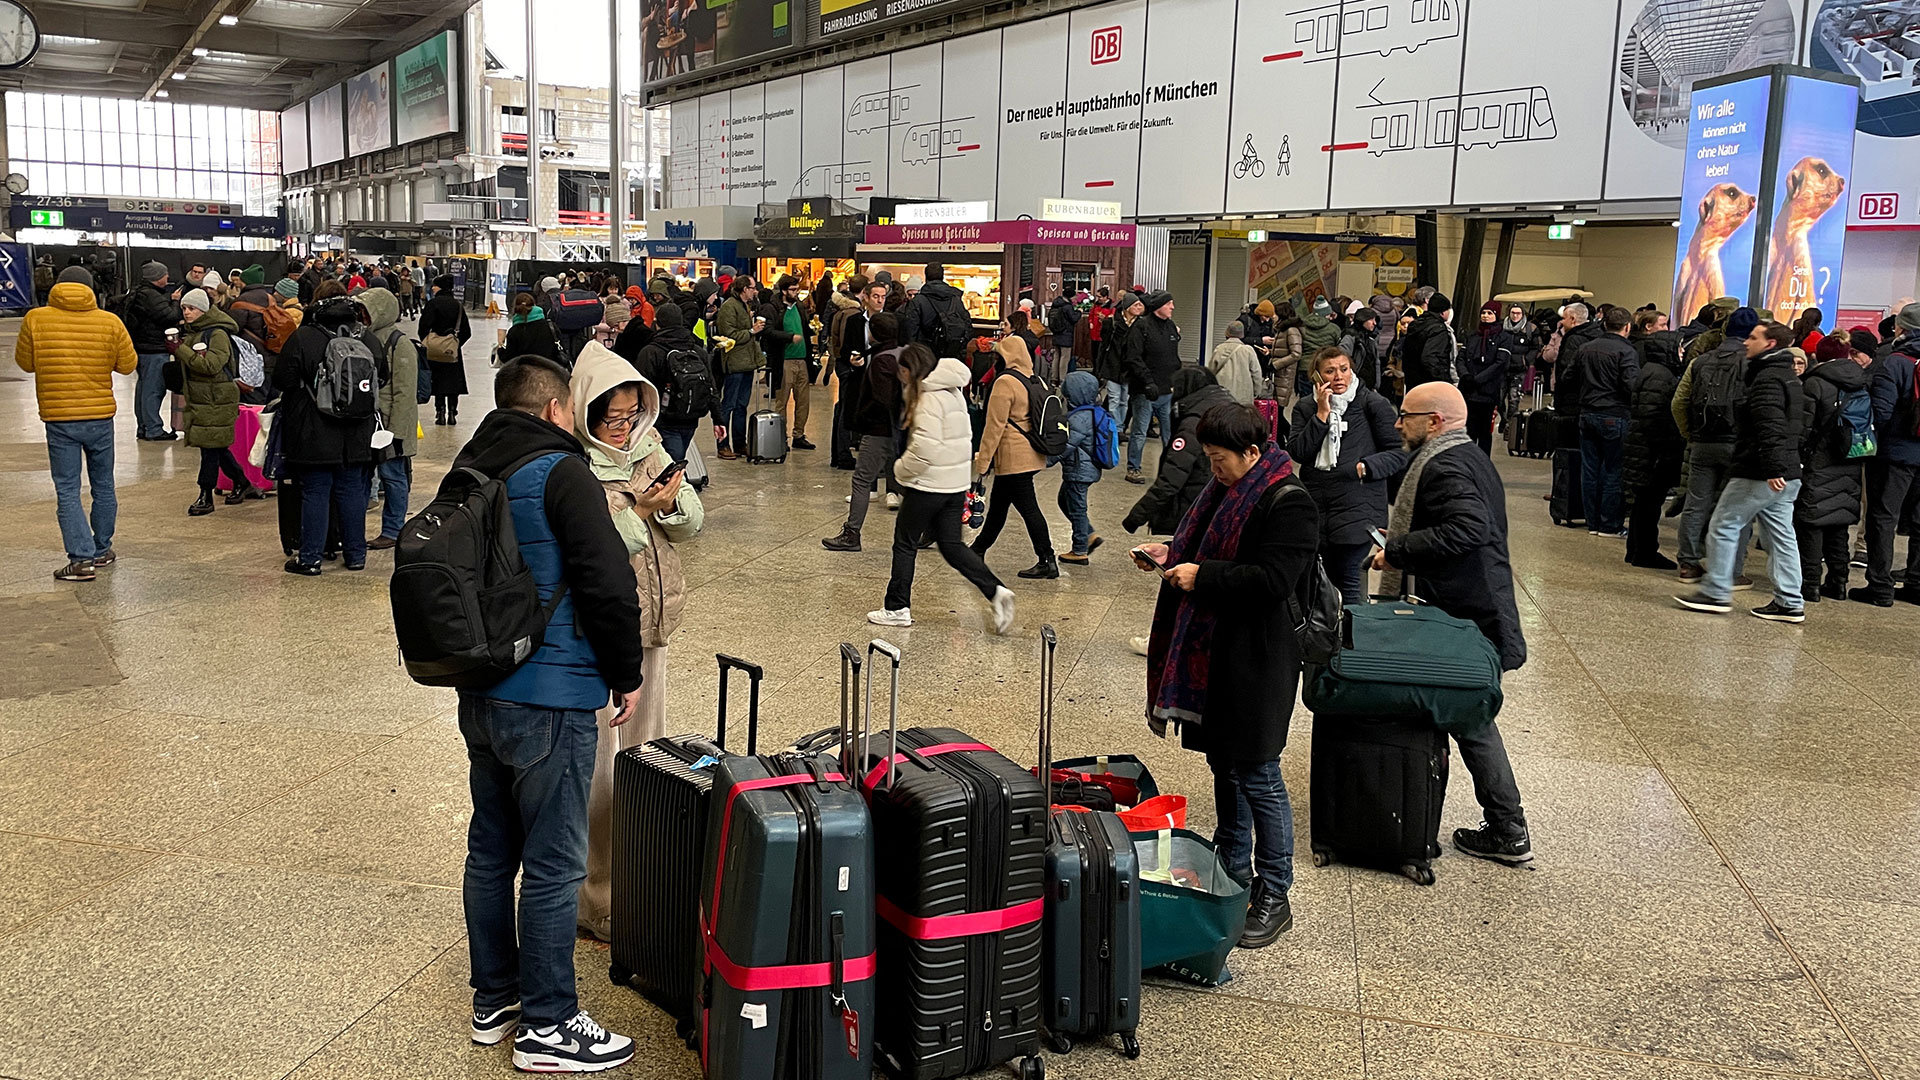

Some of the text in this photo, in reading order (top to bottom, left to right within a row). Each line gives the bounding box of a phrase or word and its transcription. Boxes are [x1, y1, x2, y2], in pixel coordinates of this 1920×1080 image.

[824, 8, 878, 33] FAHRRADLEASING
[1095, 33, 1117, 59] DB
[1007, 108, 1026, 123] Der
[1027, 105, 1053, 120] neue
[1154, 80, 1218, 103] München
[1697, 99, 1735, 120] Wir alle
[1040, 116, 1174, 140] Für Uns. Für die Umwelt. Für die Zukunft.
[1702, 121, 1747, 138] können nicht
[1697, 144, 1740, 159] ohne Natur
[1705, 162, 1729, 177] leben!
[37, 196, 72, 207] 27-36
[1864, 197, 1894, 216] DB
[790, 217, 824, 231] Höflinger
[902, 225, 980, 242] Speisen und Getränke
[1037, 226, 1130, 242] Speisen und Getränke
[1256, 256, 1278, 276] 100
[1789, 266, 1831, 305] Du ?
[359, 379, 370, 392] G
